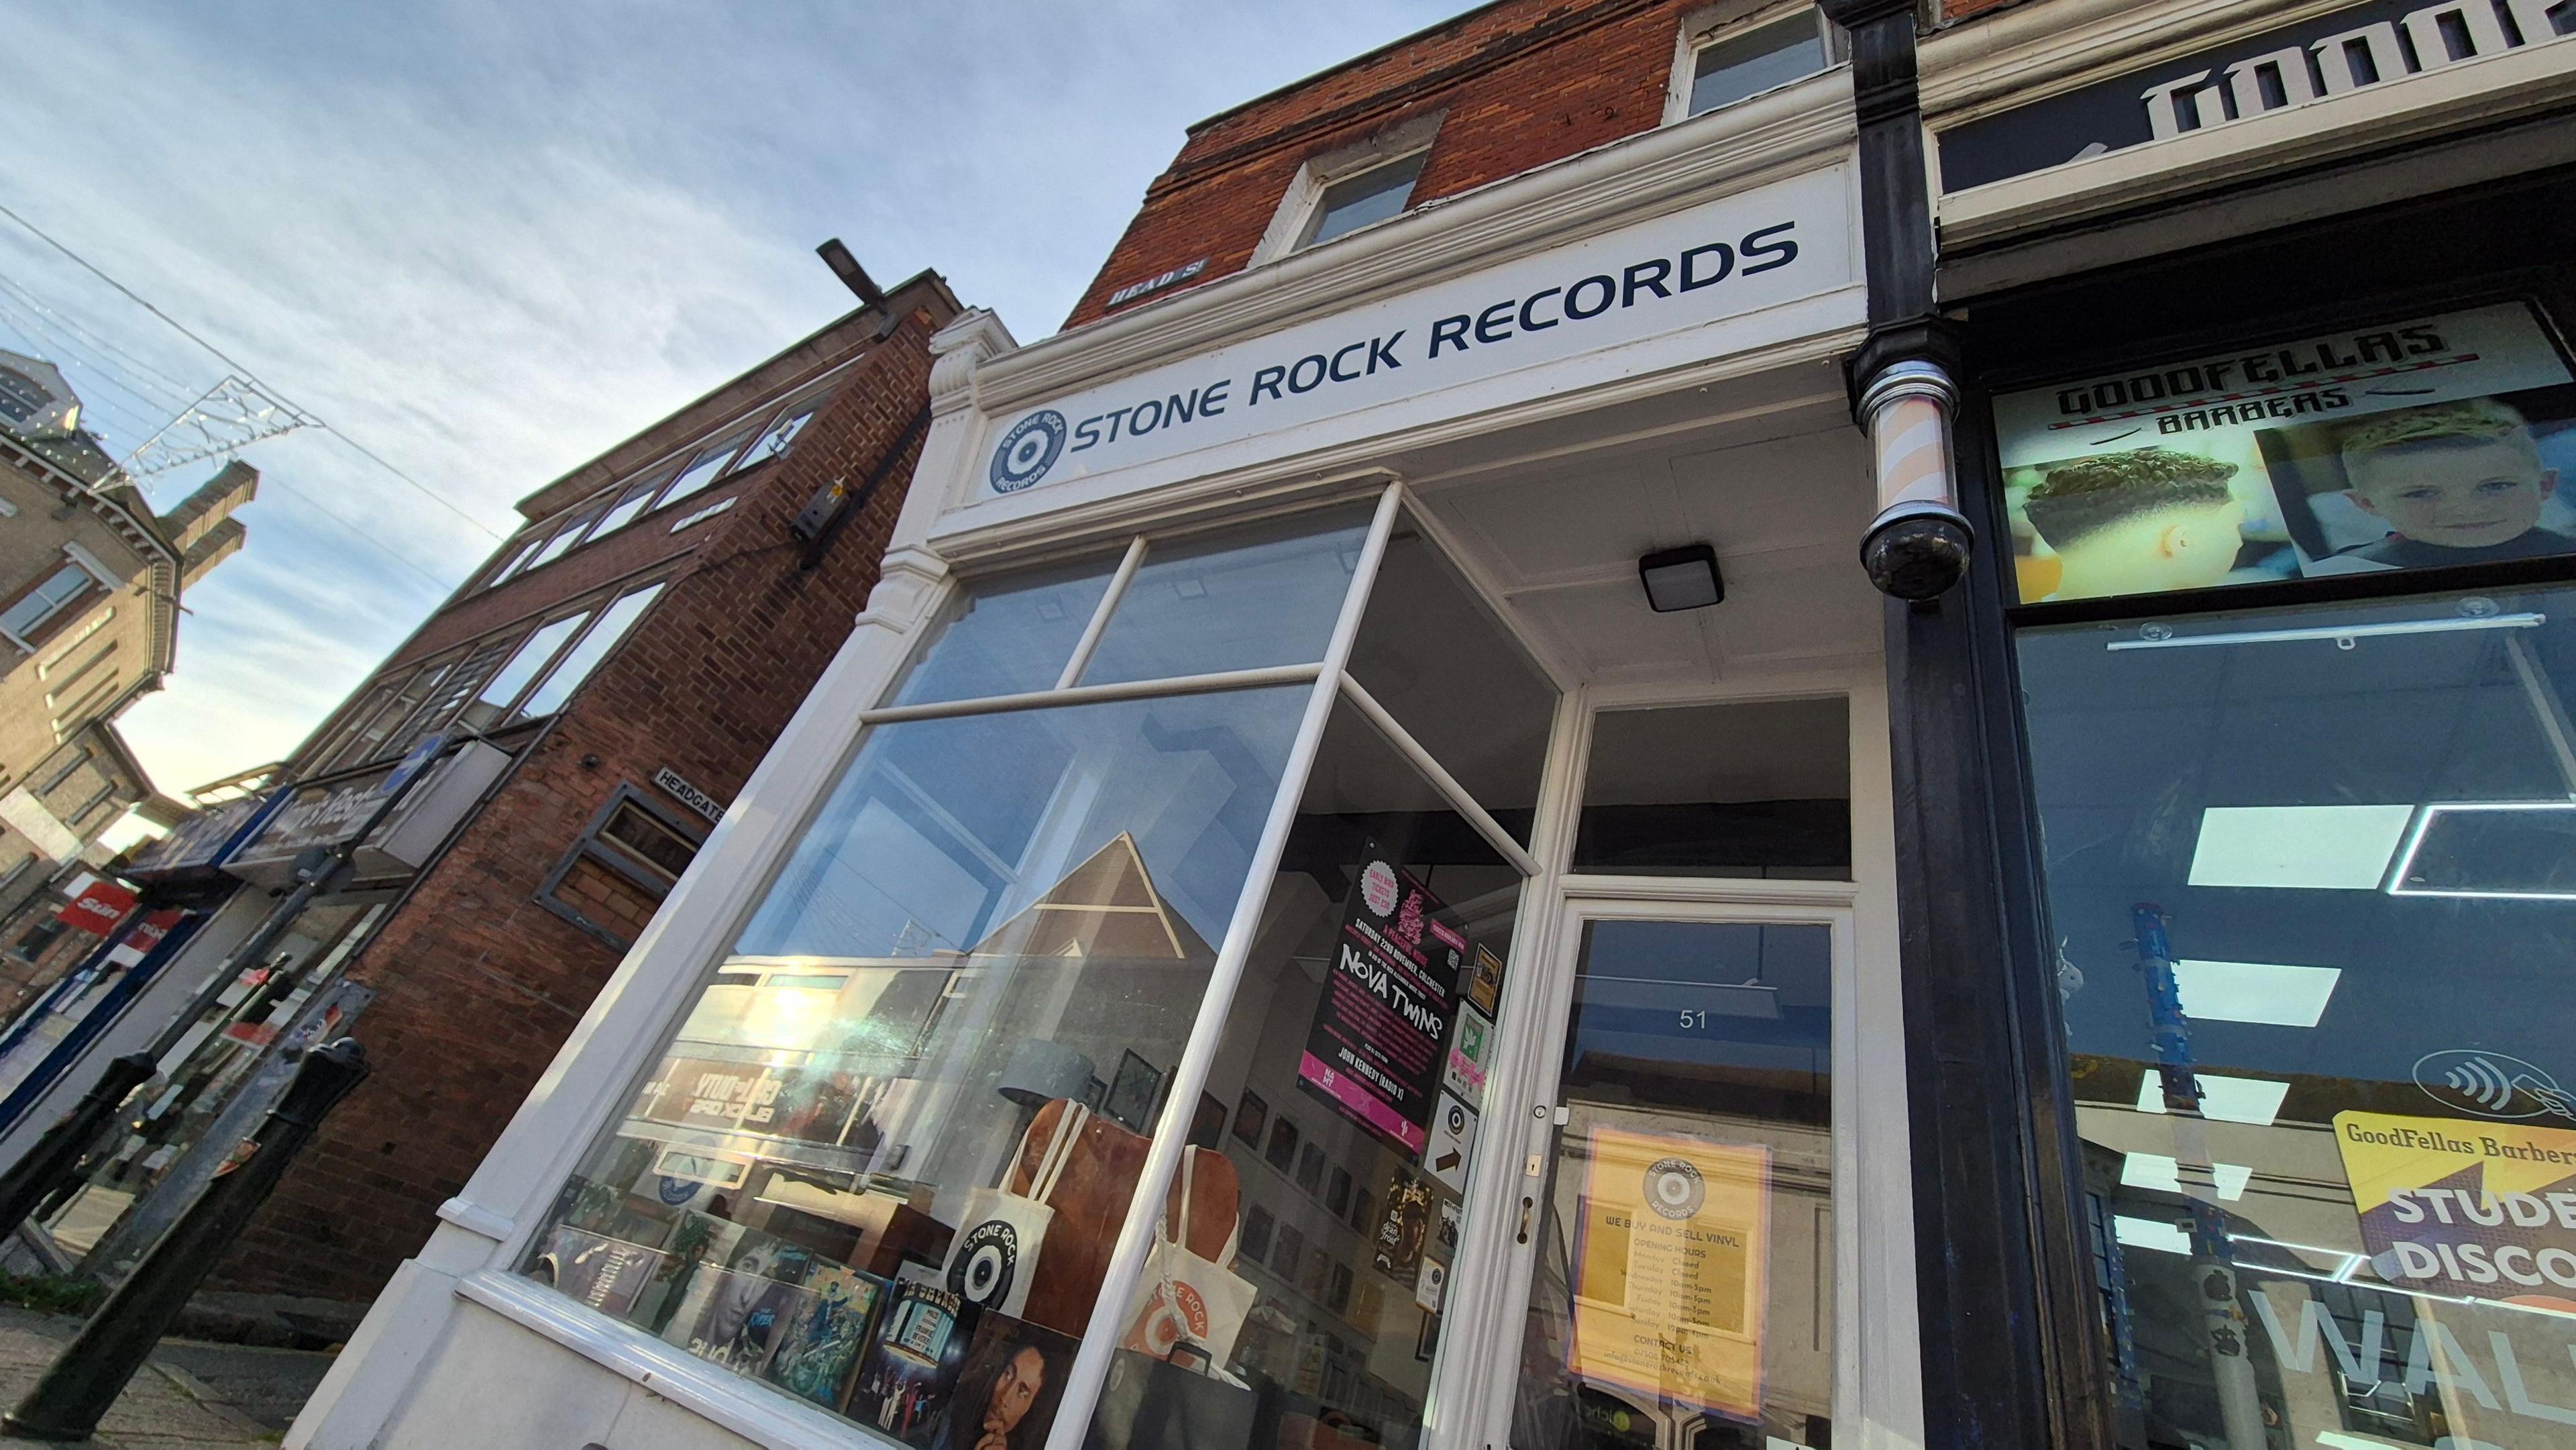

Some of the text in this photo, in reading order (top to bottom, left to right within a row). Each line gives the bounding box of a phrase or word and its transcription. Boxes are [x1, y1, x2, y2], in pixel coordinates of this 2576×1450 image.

[1108, 271, 1174, 306] HEAD
[1071, 221, 1798, 453] STONE ROCK RECORDS
[2057, 324, 2449, 415] GOODFELLAS
[2156, 386, 2353, 435] BARBERS
[1002, 413, 1064, 449] STONE ROCK
[996, 464, 1046, 492] RECORDS
[76, 897, 121, 919] Sun
[1355, 918, 1381, 945] SATURDAY
[1381, 939, 1394, 955] 22ND
[1393, 947, 1418, 977] NOVEMBER,
[1419, 969, 1446, 998] COLCHESTER
[1340, 943, 1387, 998] NOVA
[1393, 984, 1442, 1040] TWINS
[1680, 1010, 1706, 1029] 51
[1338, 1047, 1354, 1066] JOHN
[1354, 1055, 1380, 1081] KENNEDY
[1379, 1074, 1397, 1095] (RADIO
[1397, 1089, 1405, 1102] X)
[2347, 1123, 2475, 1155] GoodFellas
[1648, 1160, 1702, 1184] STONE ROCK
[1652, 1200, 1693, 1219] RECORDS
[964, 1225, 1016, 1266] STONE ROCK
[1606, 1215, 1739, 1247] WE BUY AND SELL VINYL
[1633, 1239, 1707, 1259] OPENING HOURS
[1672, 1257, 1699, 1269] Closed
[1633, 1261, 1699, 1280] Tuesday Closed
[1670, 1279, 1711, 1294] 10am-5pm
[1629, 1282, 1711, 1305] Thursday 10am-5pm
[1669, 1300, 1710, 1316] 10am-5pm
[1185, 1293, 1205, 1331] ROCK
[1633, 1335, 1692, 1355] CONTACT US
[2248, 1289, 2576, 1427] WAL
